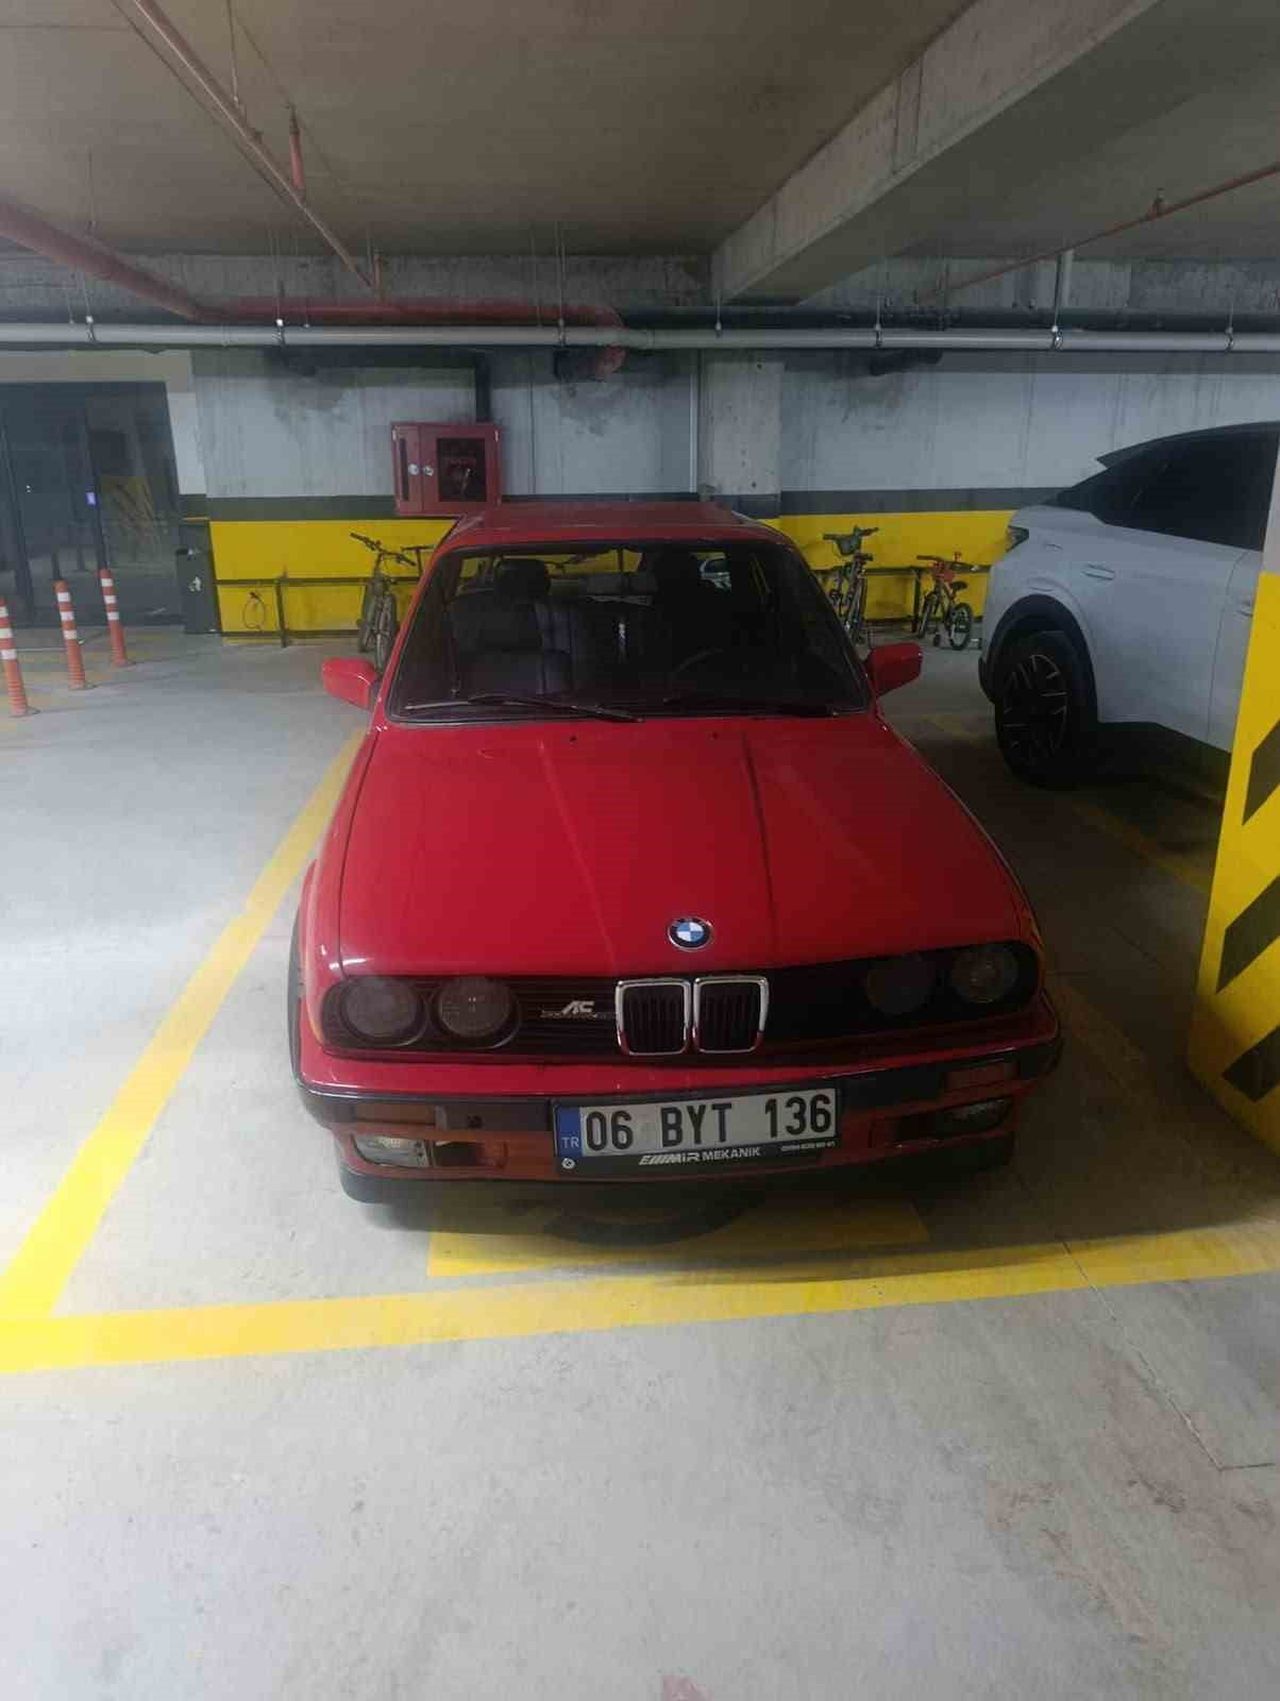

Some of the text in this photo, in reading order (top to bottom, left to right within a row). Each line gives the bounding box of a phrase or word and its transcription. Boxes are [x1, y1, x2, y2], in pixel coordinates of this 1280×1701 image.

[585, 1093, 831, 1152] 06 BYT 136
[561, 1136, 580, 1149] TR
